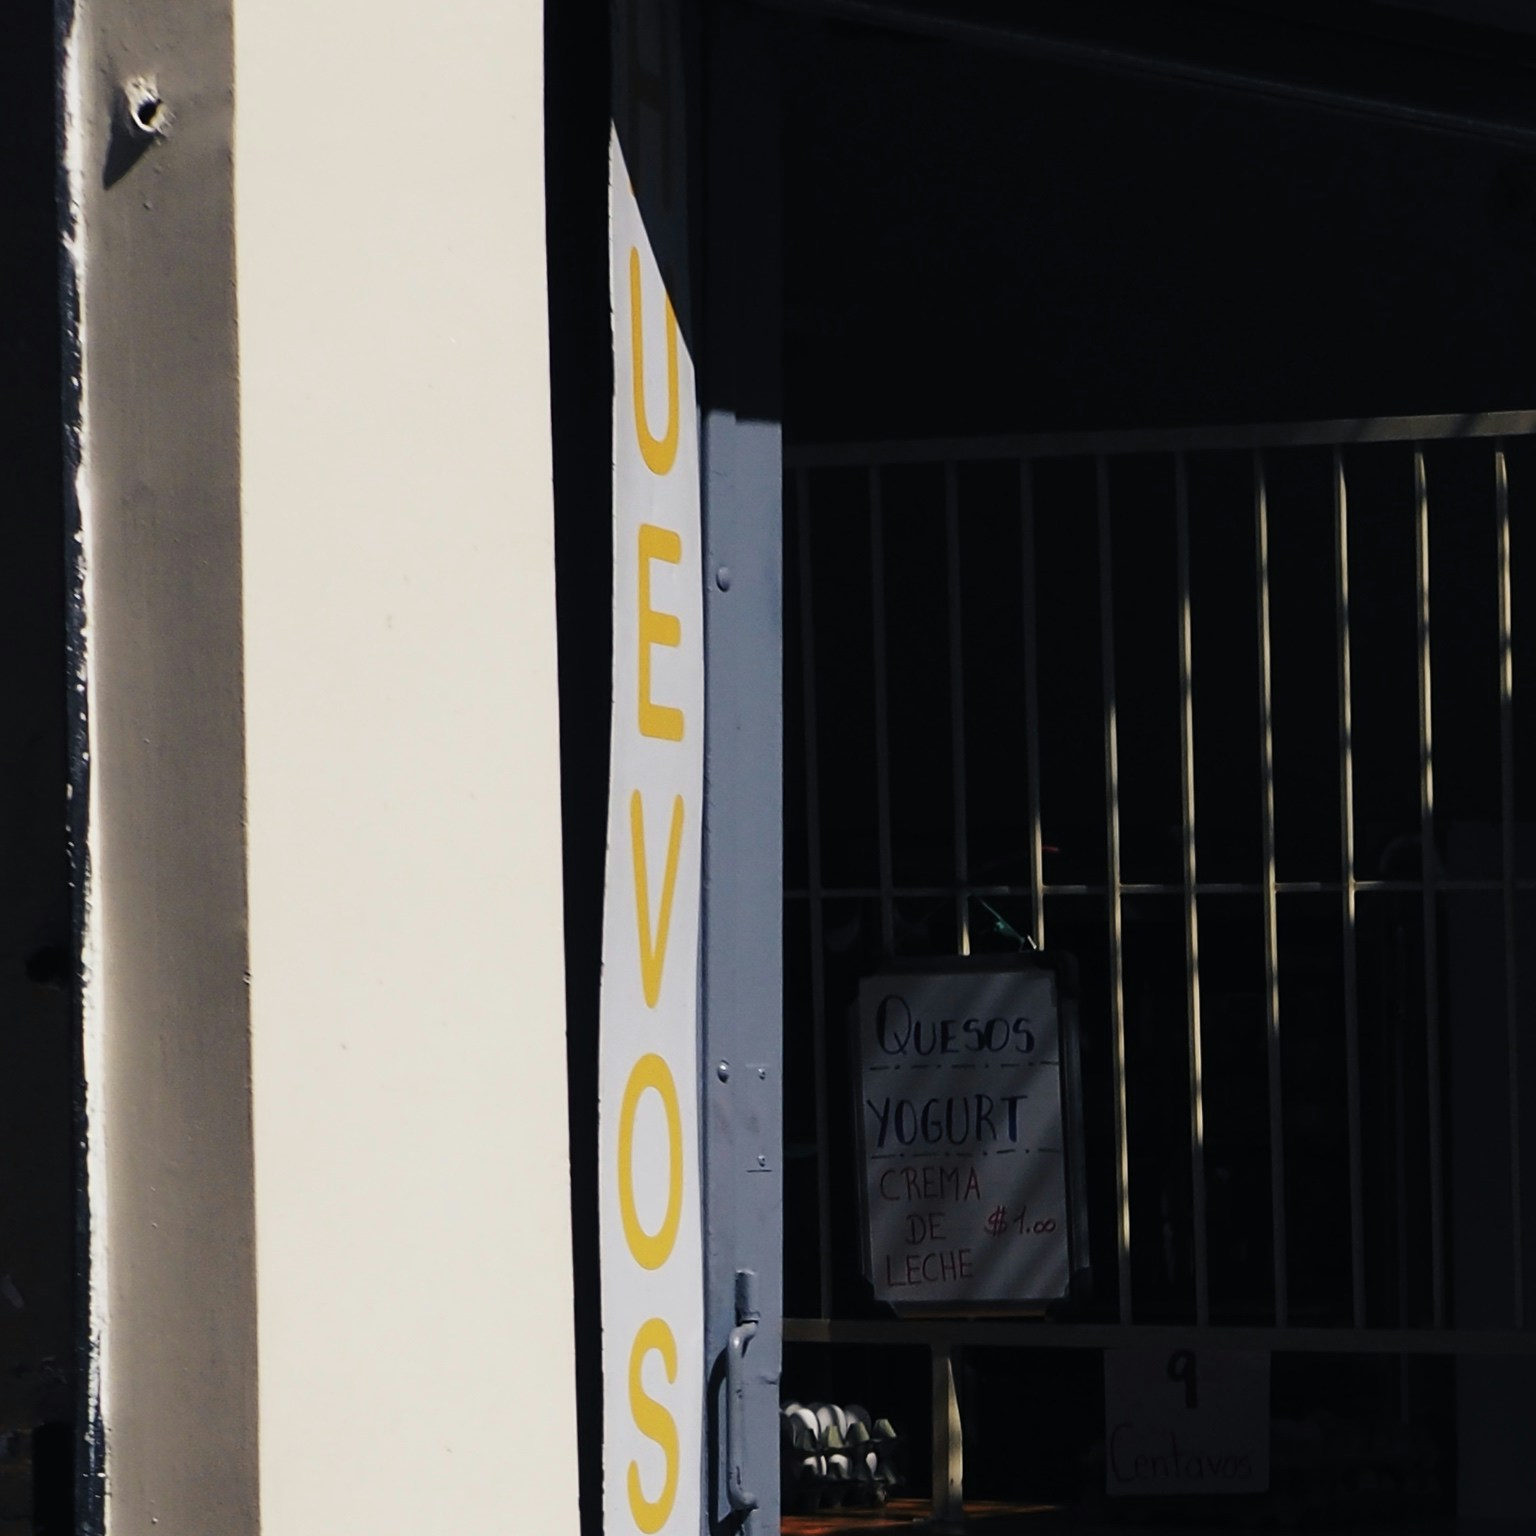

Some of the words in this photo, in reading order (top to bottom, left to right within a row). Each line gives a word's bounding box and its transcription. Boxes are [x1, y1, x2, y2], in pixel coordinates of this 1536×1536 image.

[866, 1093, 1029, 1149] YOGURT
[879, 1165, 981, 1202] CREMA
[905, 1211, 947, 1246] DE
[886, 1248, 975, 1288] LECHE
[1167, 1349, 1198, 1409] 9
